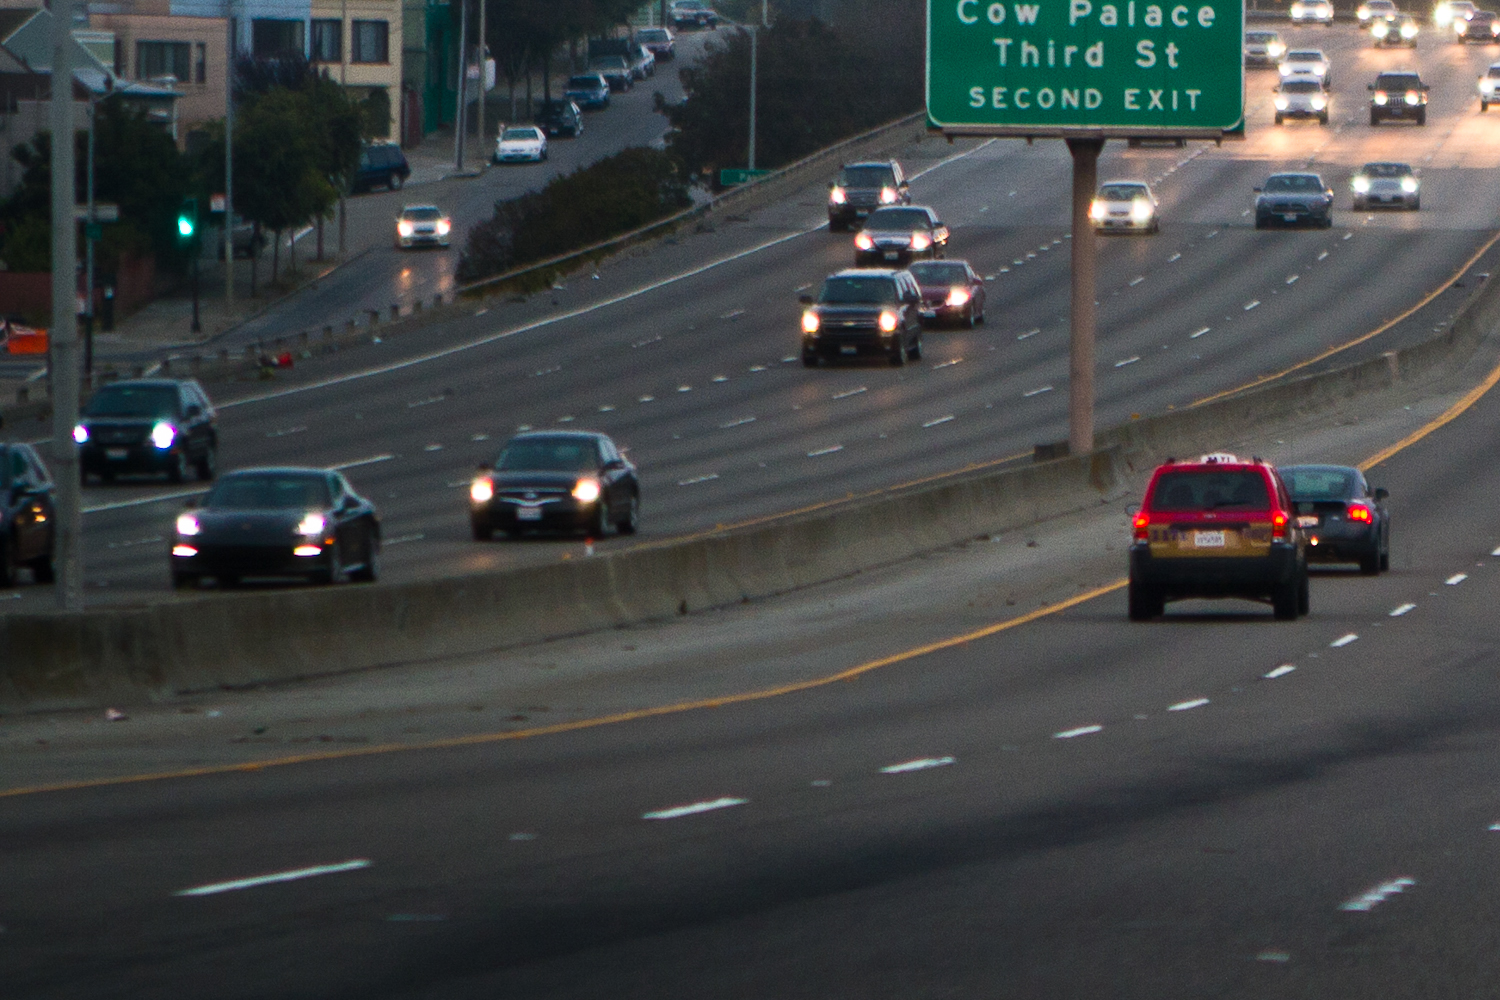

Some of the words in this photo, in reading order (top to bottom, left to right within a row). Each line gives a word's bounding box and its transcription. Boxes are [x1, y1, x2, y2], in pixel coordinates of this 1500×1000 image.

[992, 37, 1104, 67] Third
[1135, 39, 1179, 68] St
[968, 86, 1104, 109] SECOND
[1123, 88, 1201, 110] EXIT
